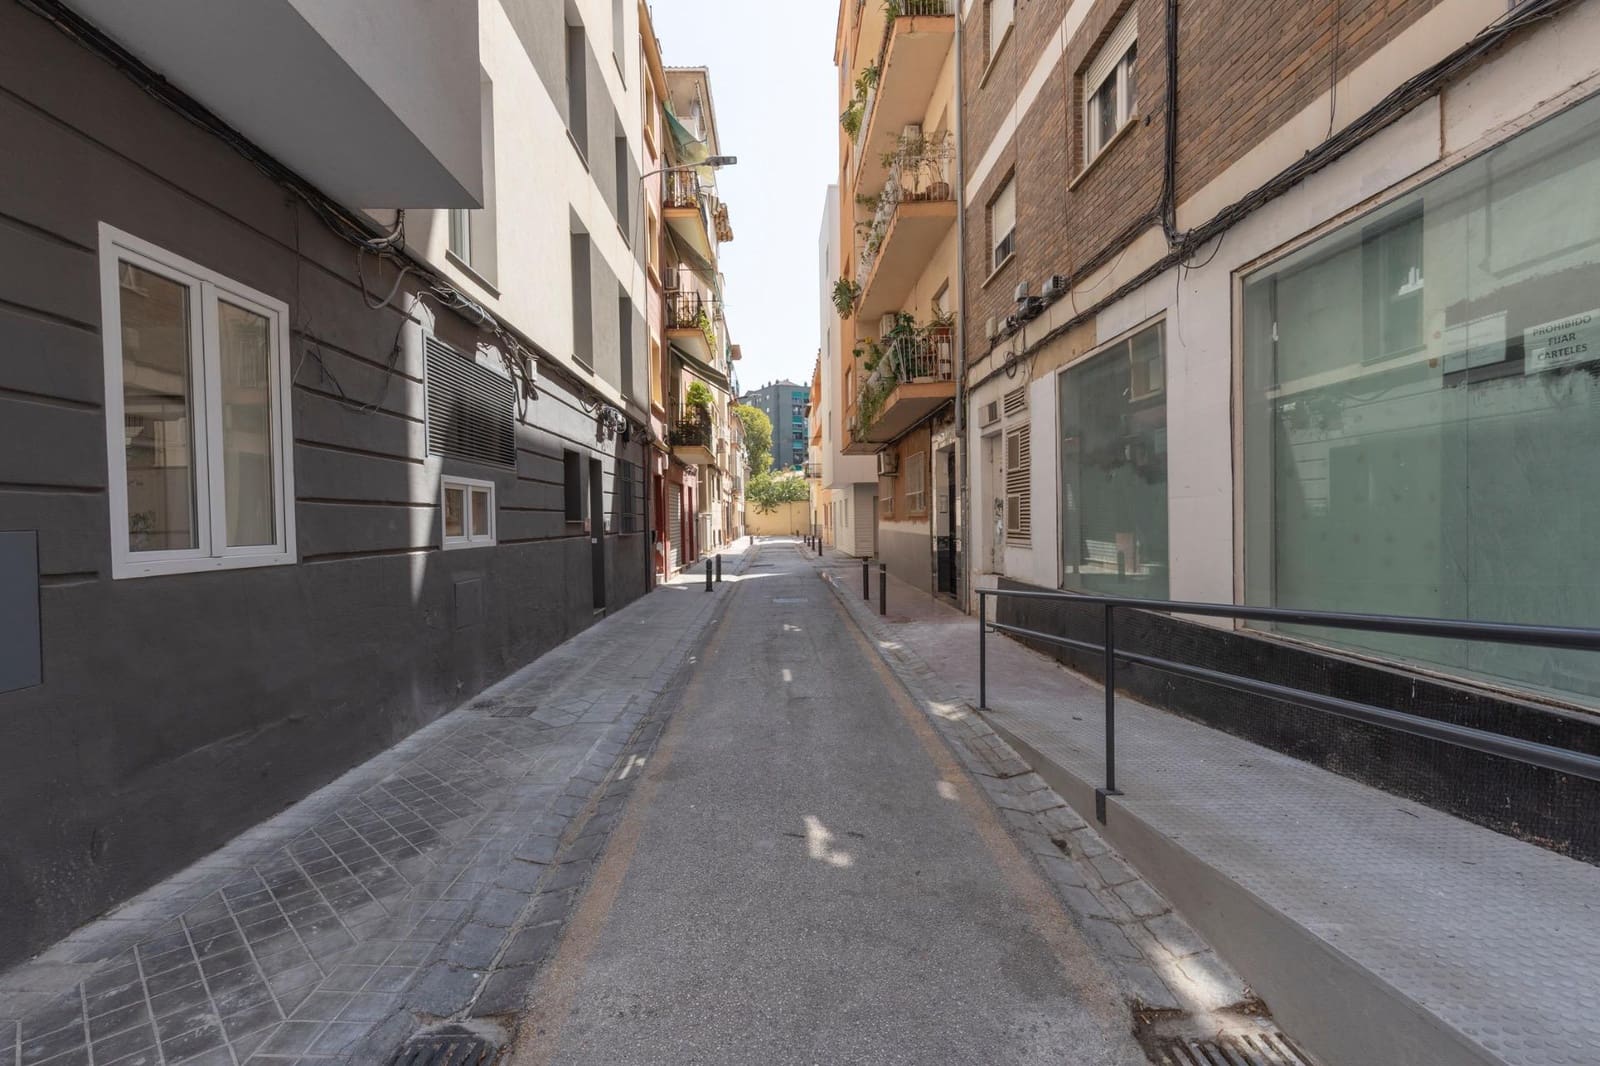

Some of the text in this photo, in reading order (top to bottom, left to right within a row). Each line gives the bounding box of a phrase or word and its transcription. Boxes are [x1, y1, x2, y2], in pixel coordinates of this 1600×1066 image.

[1533, 315, 1592, 336] PROHIBIDO
[1548, 332, 1576, 346] FIJAR
[1537, 343, 1588, 361] CARTELES
